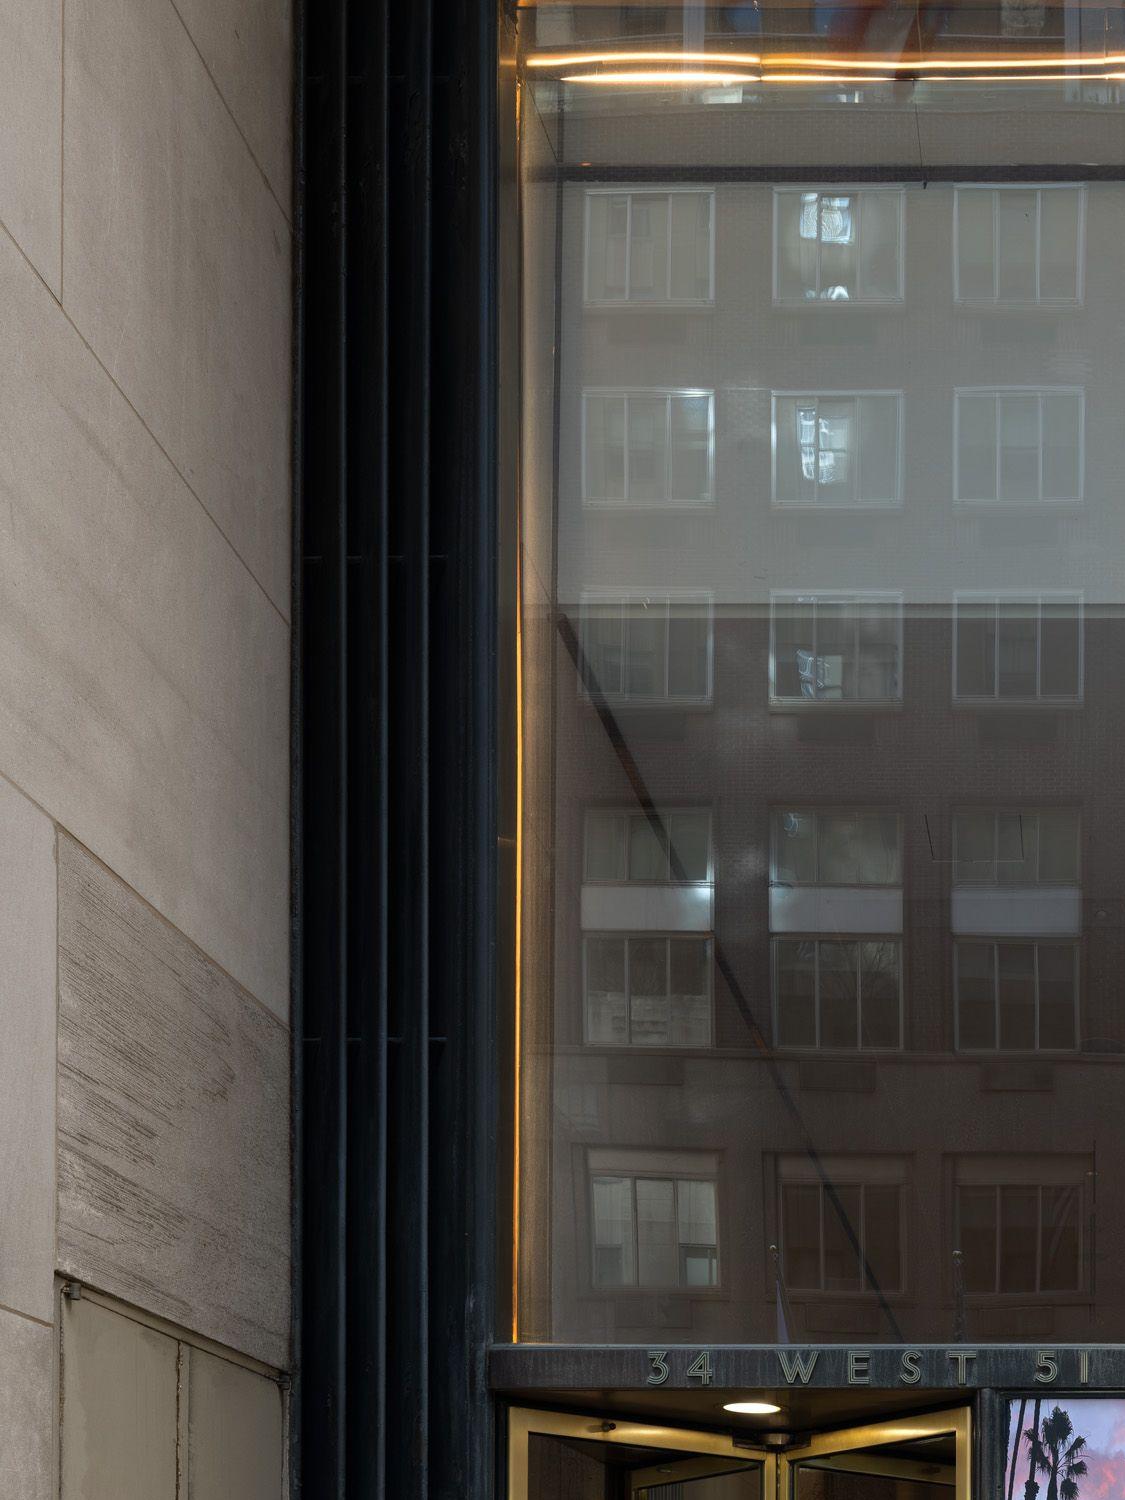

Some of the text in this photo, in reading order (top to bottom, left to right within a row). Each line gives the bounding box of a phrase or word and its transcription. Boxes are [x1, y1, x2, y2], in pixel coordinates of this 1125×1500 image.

[647, 1350, 713, 1385] 34
[776, 1350, 977, 1385] WEST
[1033, 1349, 1089, 1384] 51
